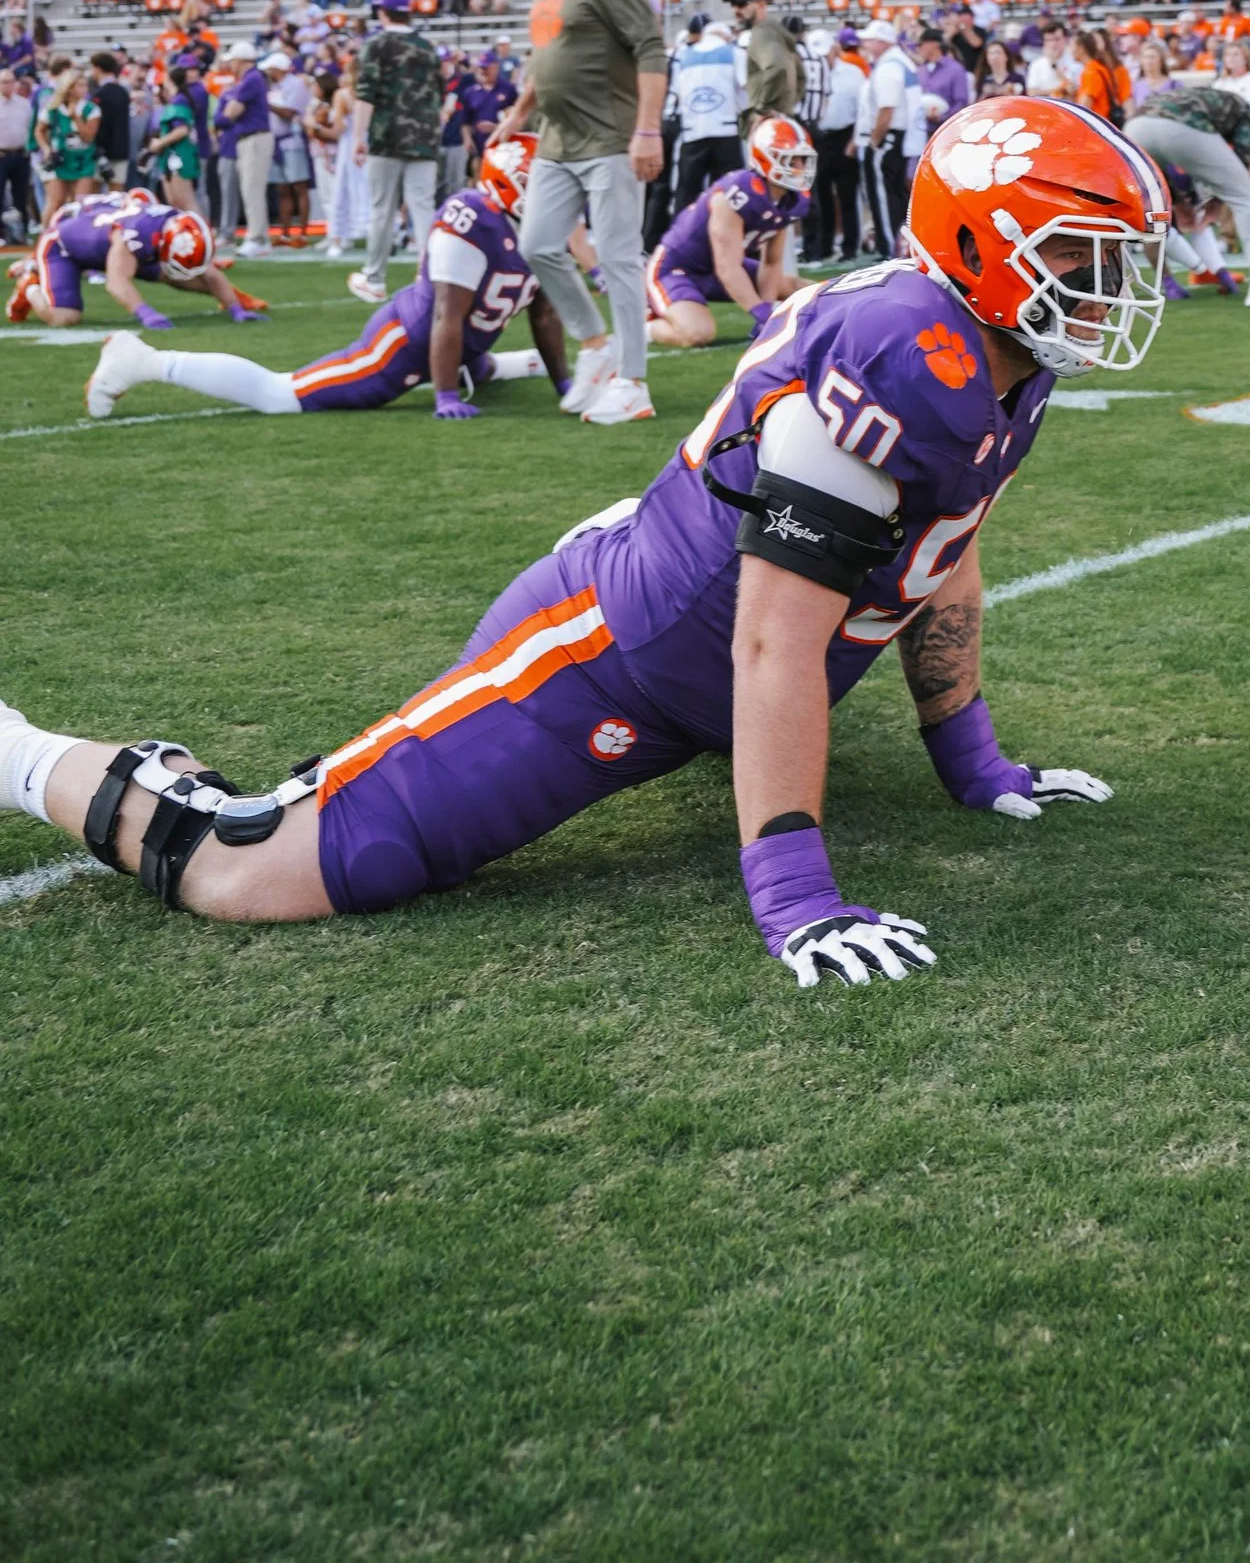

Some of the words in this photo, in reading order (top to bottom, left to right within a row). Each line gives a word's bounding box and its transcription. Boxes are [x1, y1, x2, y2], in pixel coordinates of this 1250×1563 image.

[442, 198, 479, 235] 56
[817, 366, 903, 468] 50
[776, 518, 820, 542] Douglas
